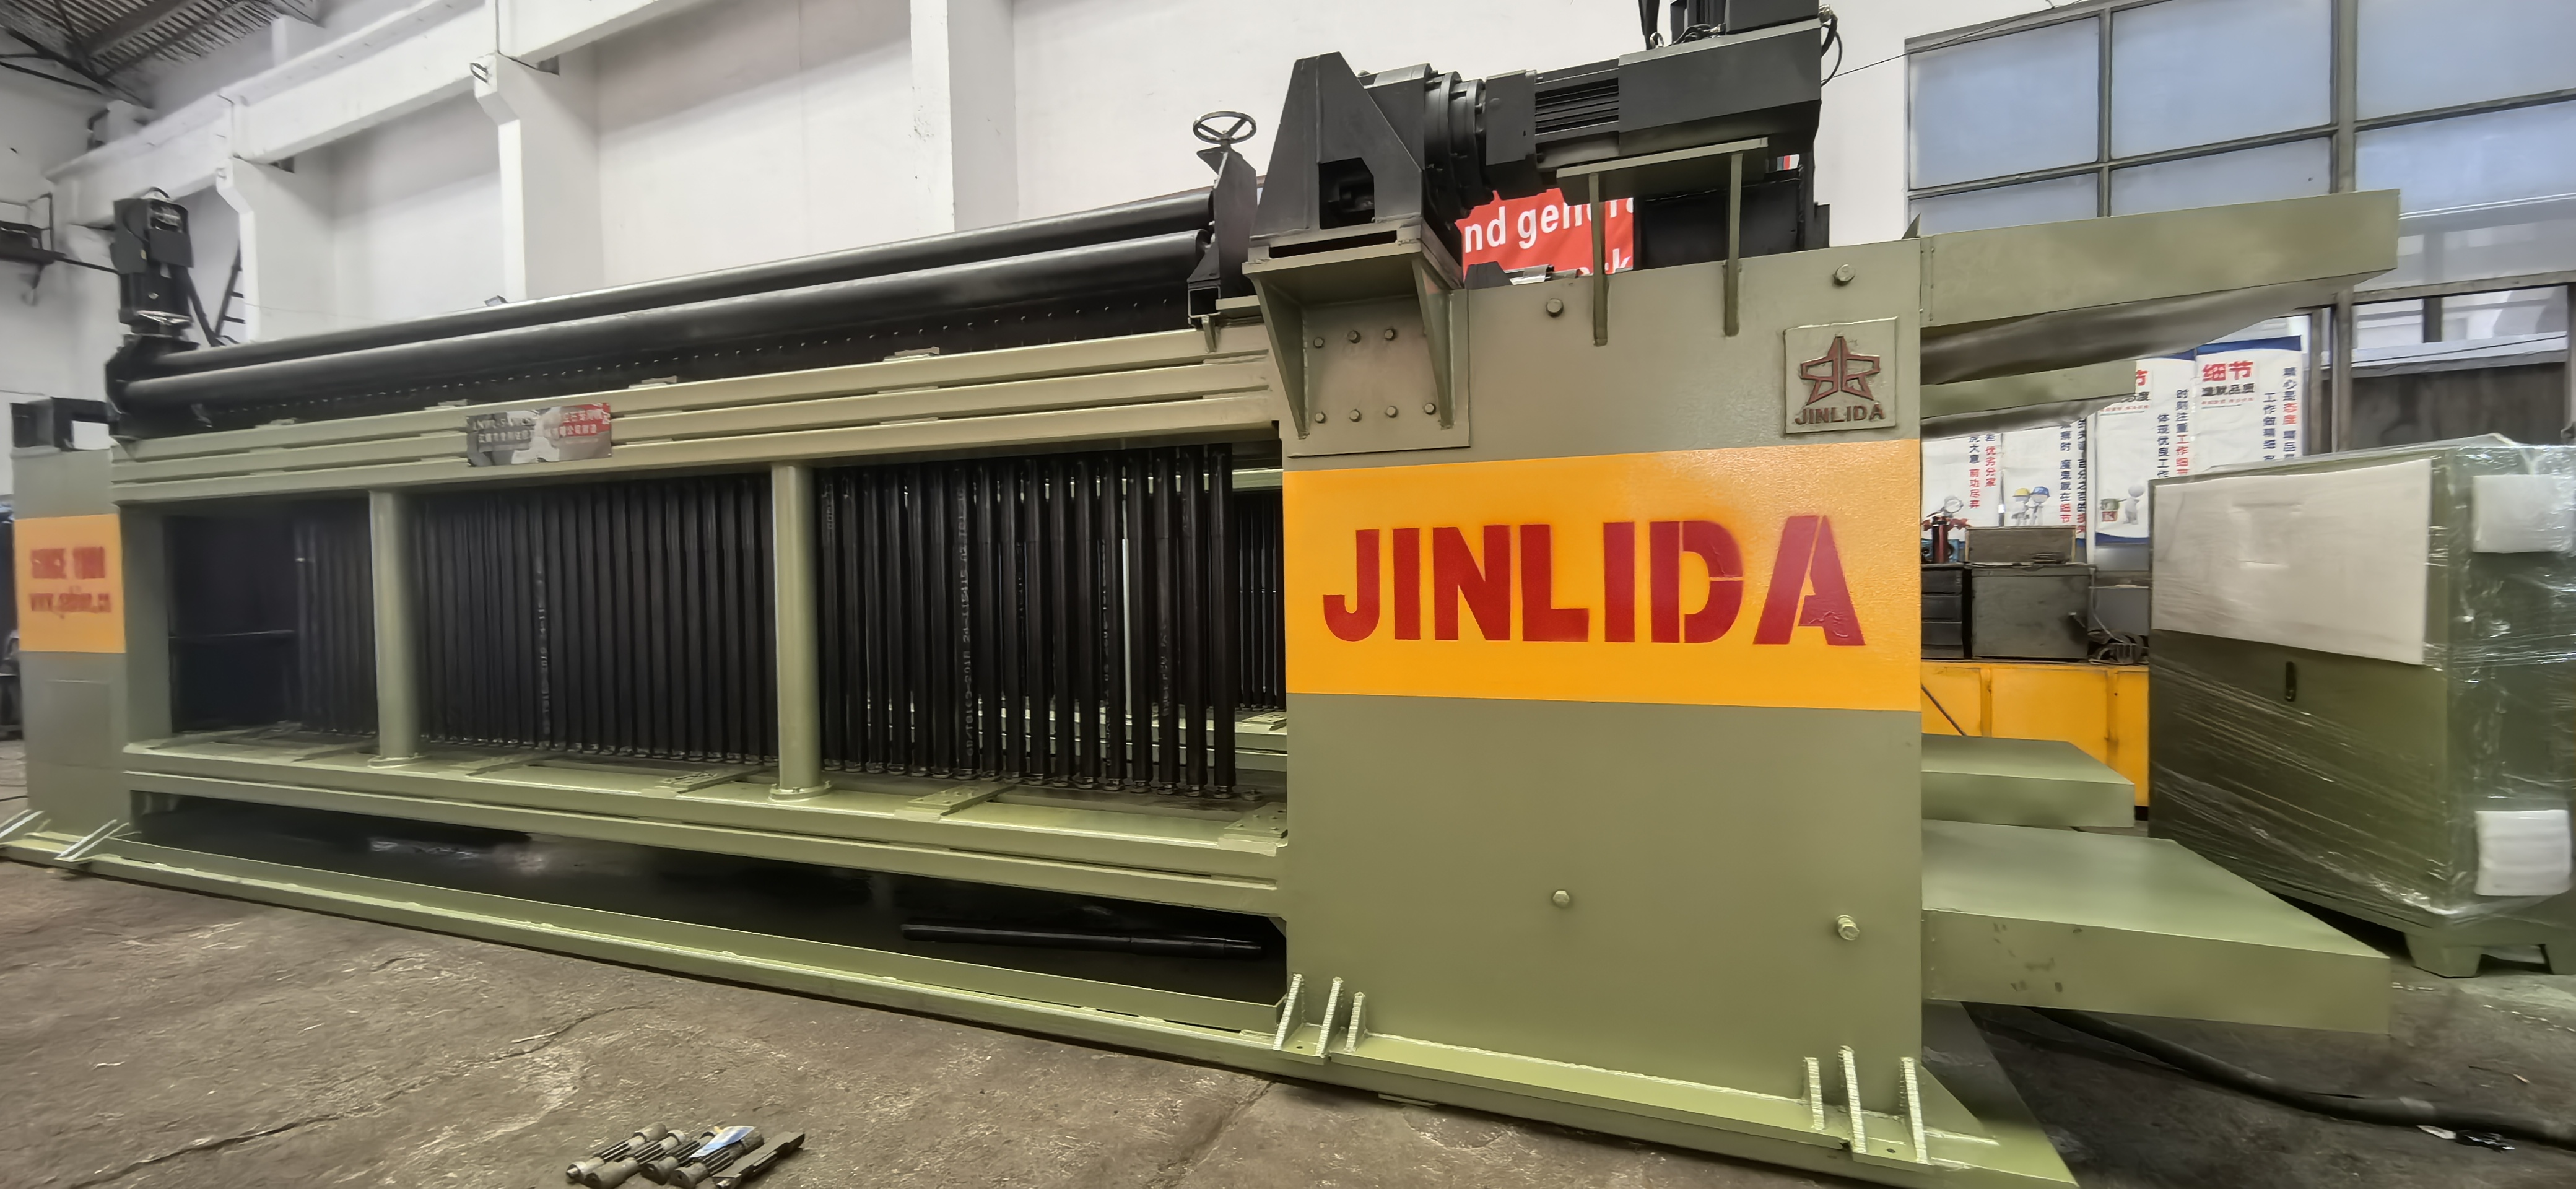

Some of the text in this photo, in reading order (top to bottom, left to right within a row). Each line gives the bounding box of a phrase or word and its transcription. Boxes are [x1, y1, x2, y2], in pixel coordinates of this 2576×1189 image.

[2202, 360, 2253, 382] 细节
[1794, 403, 1887, 425] JINLIDA
[1323, 515, 1866, 646] JINLIDA
